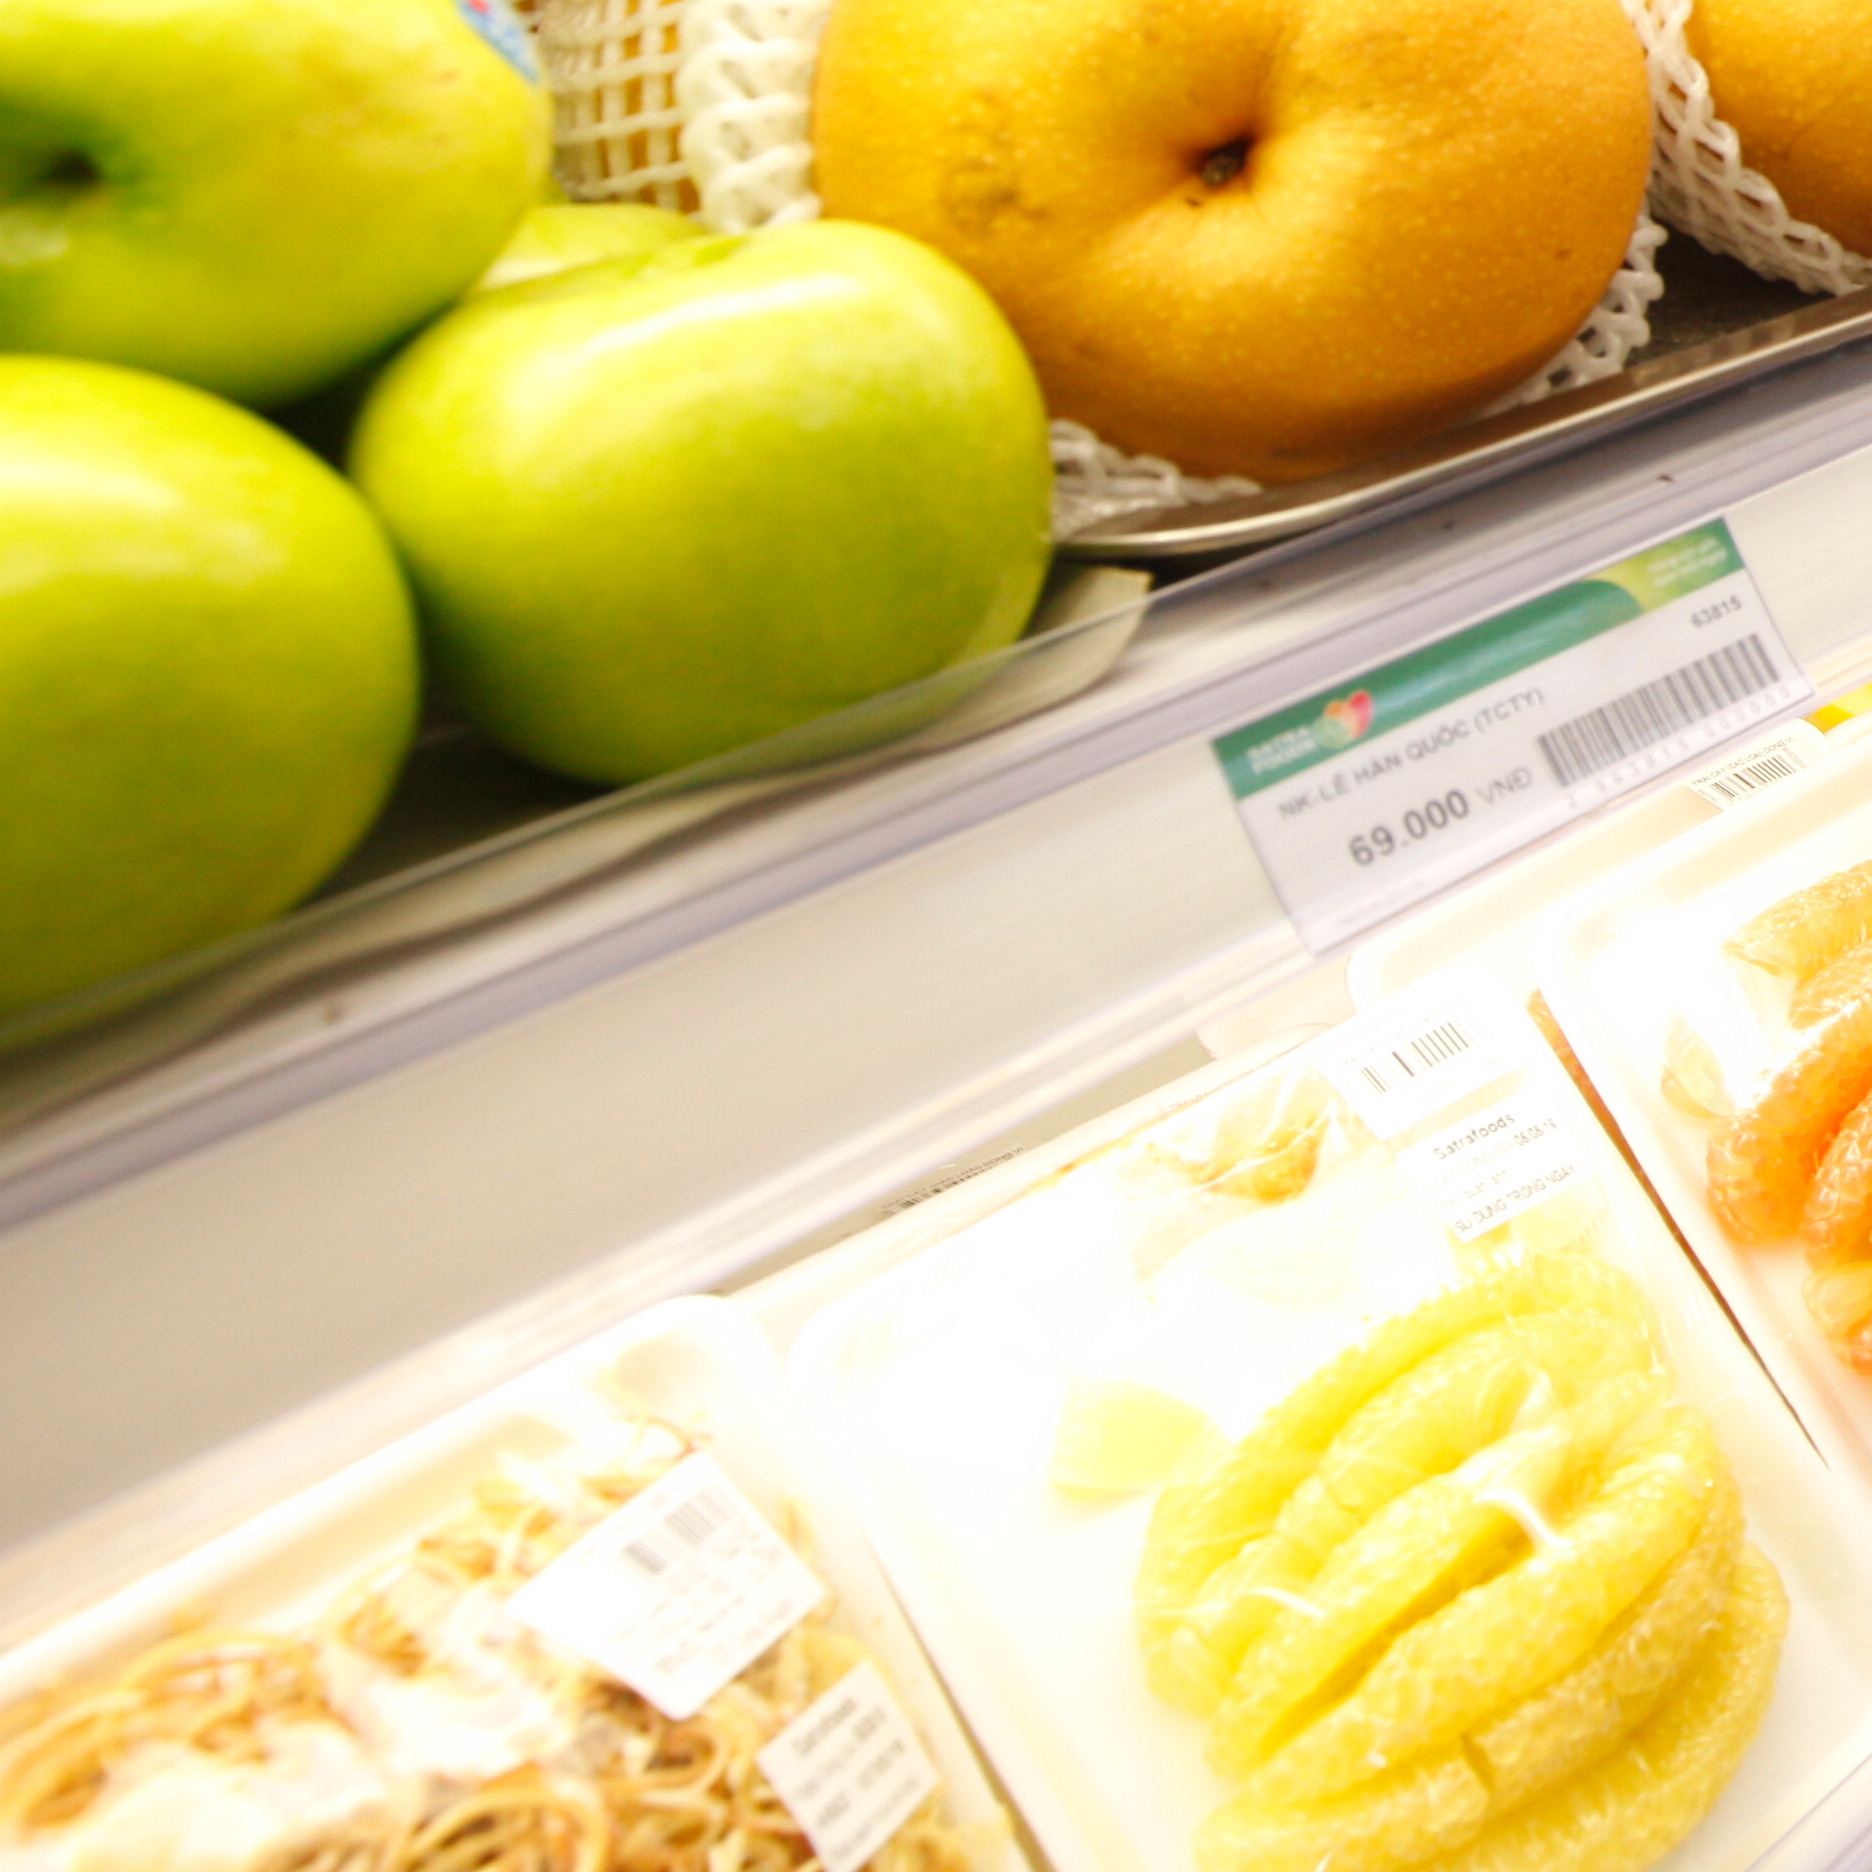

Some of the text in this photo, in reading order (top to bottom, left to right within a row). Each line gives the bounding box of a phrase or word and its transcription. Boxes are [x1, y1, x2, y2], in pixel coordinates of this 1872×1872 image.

[1348, 790, 1470, 868] 69.000
[1433, 1110, 1515, 1162] Satrafoods
[1507, 1178, 1546, 1206] TRONG
[1545, 1163, 1575, 1187] NGAY
